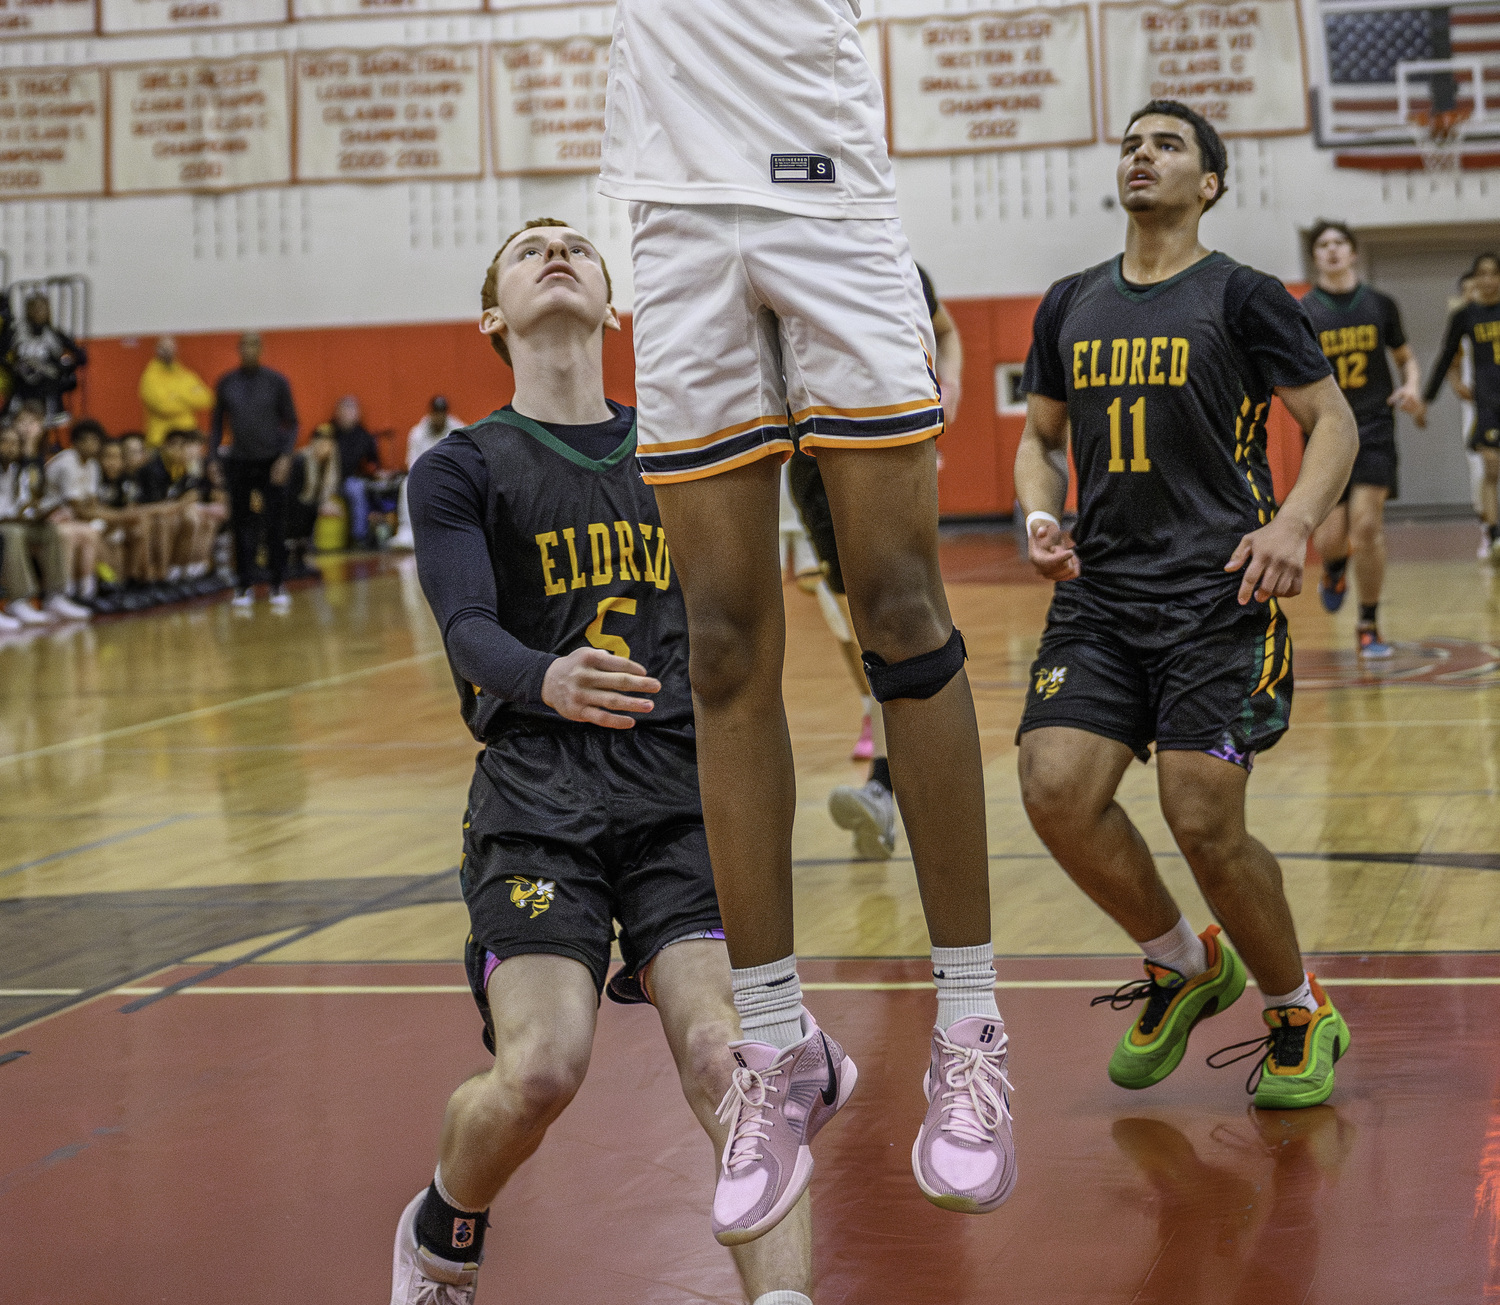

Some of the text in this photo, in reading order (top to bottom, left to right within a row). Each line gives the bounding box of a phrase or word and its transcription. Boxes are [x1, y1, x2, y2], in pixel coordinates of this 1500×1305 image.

[816, 163, 826, 174] S
[1073, 337, 1190, 389] ELDRED
[1337, 352, 1368, 388] 12
[1107, 396, 1151, 472] 11
